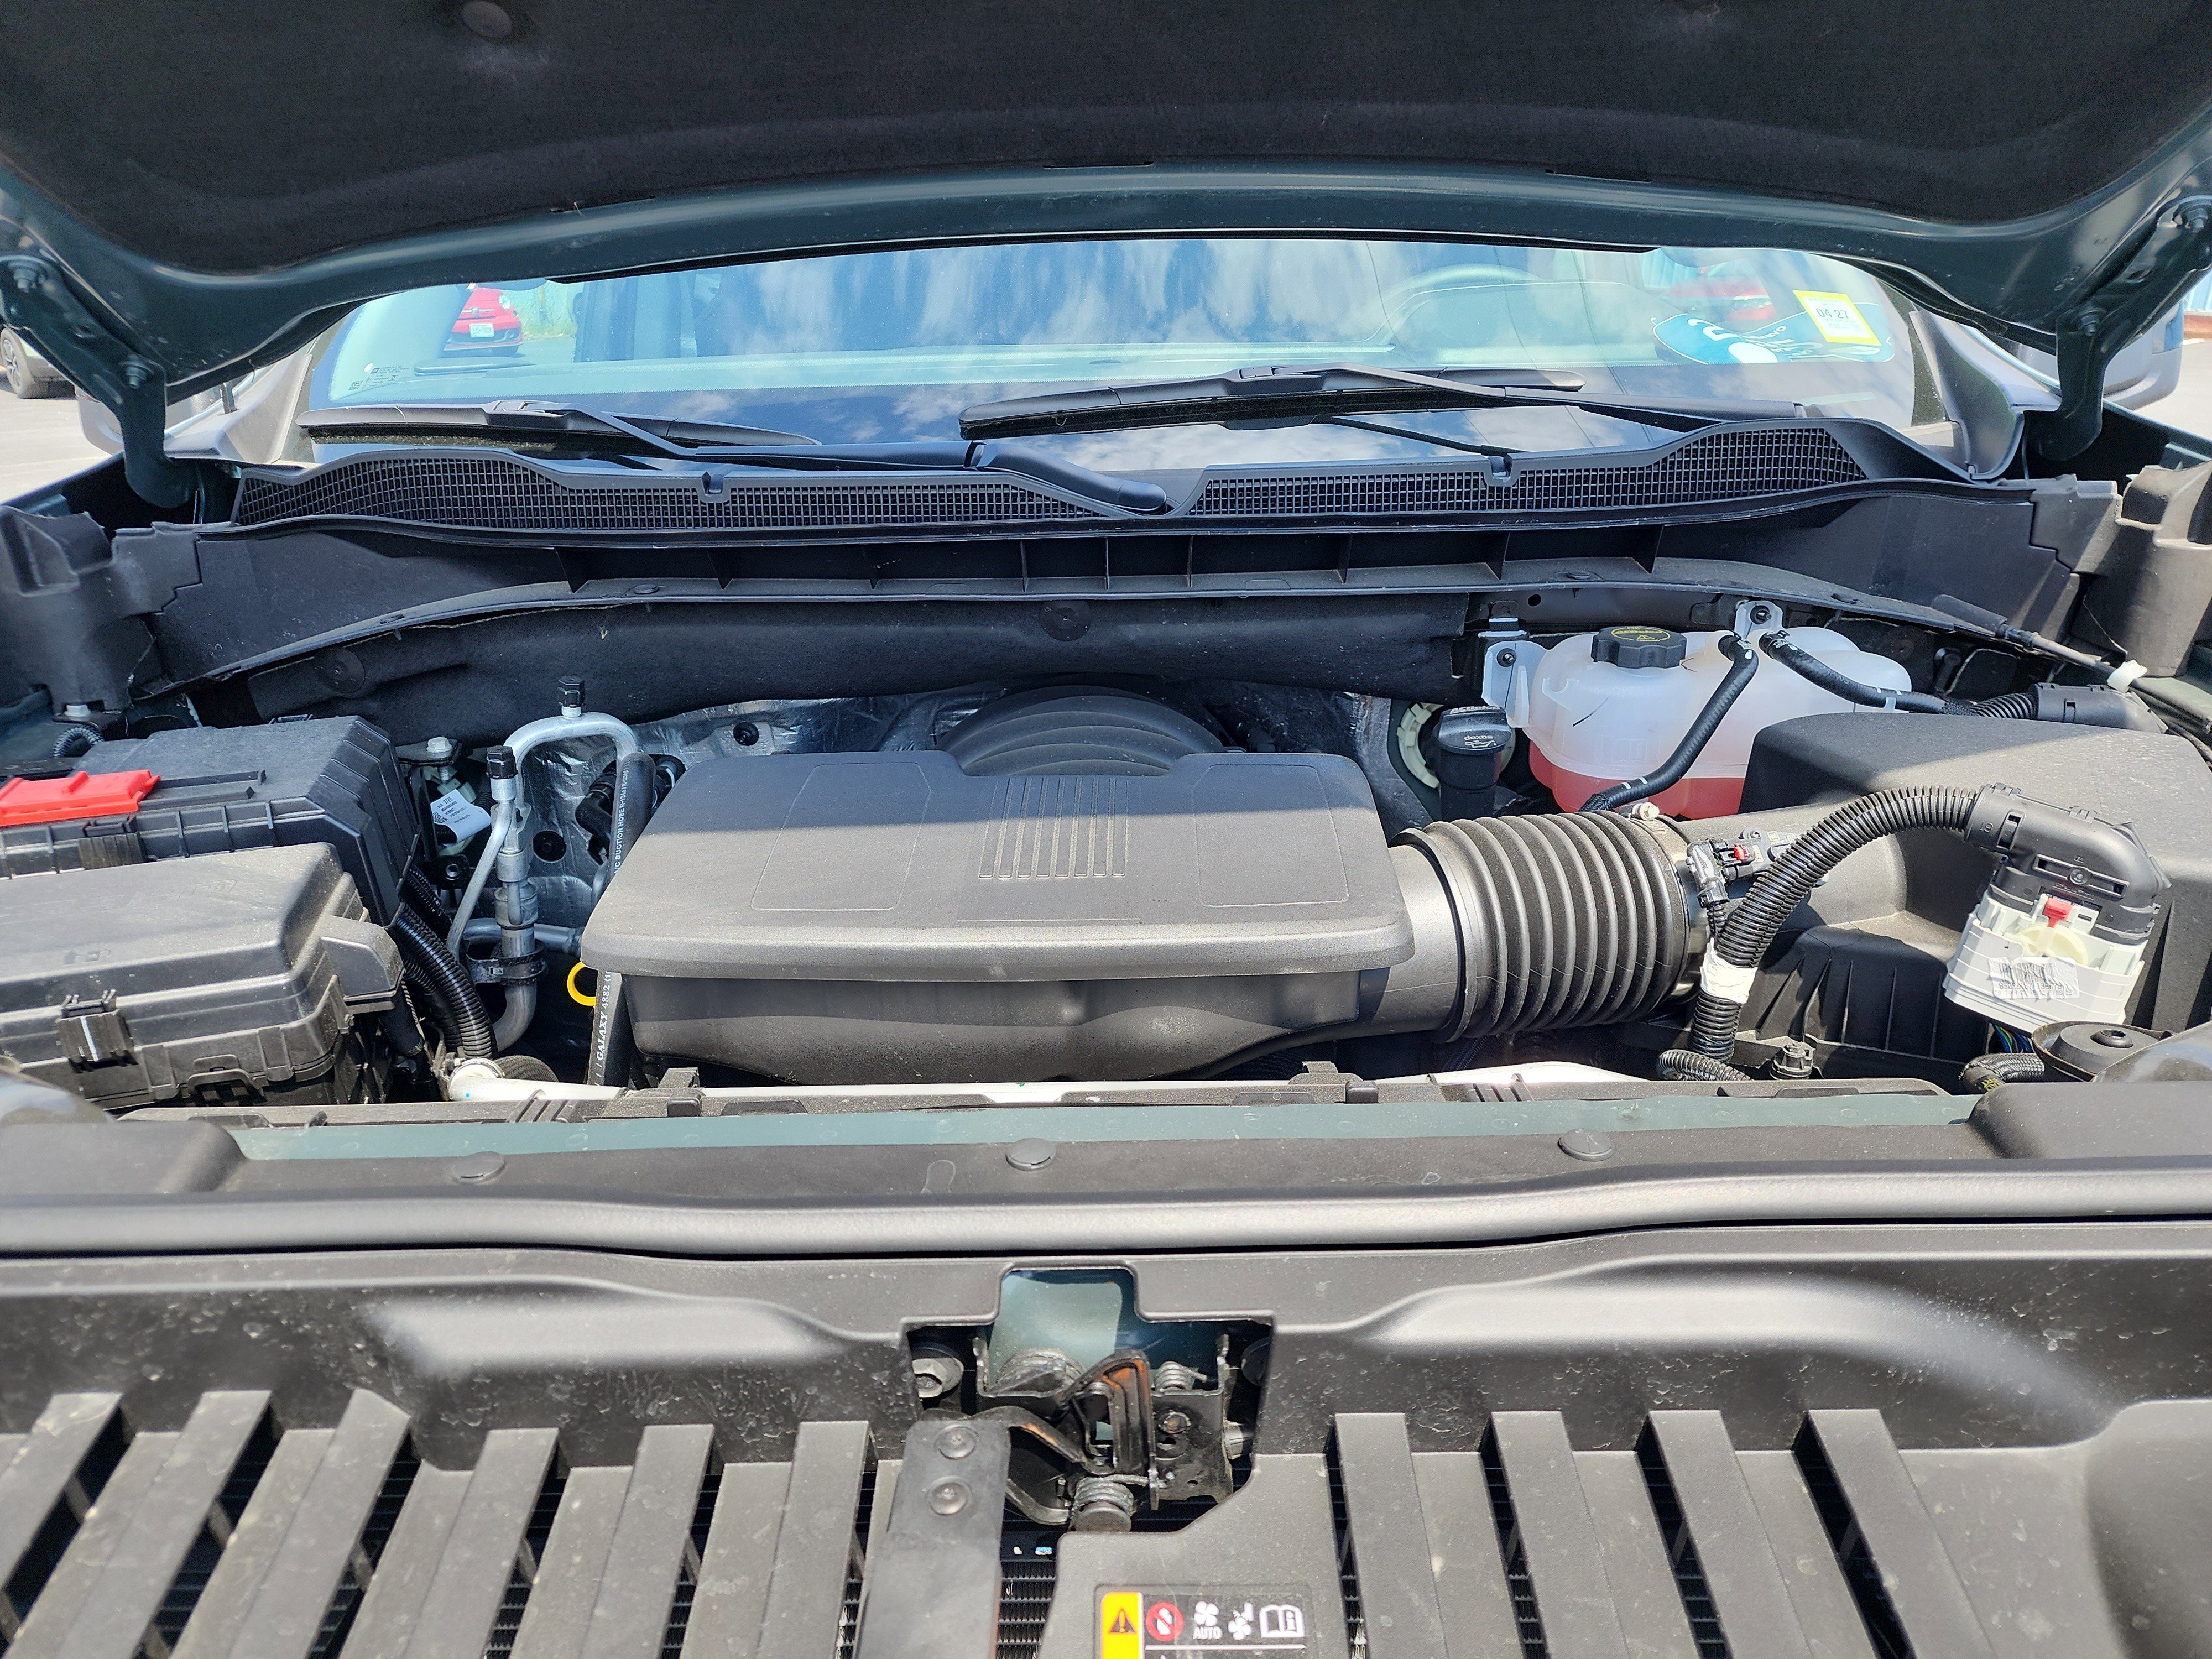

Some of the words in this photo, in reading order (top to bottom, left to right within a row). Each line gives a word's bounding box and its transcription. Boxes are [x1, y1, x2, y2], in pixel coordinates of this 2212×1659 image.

[1816, 308, 1832, 318] 04
[1834, 309, 1849, 319] 27
[1449, 705, 1500, 714] ACDelco
[615, 828, 624, 860] SUCTION
[601, 985, 611, 1009] 4882
[596, 1011, 608, 1061] GALAXY
[1193, 1626, 1222, 1640] AUTO
